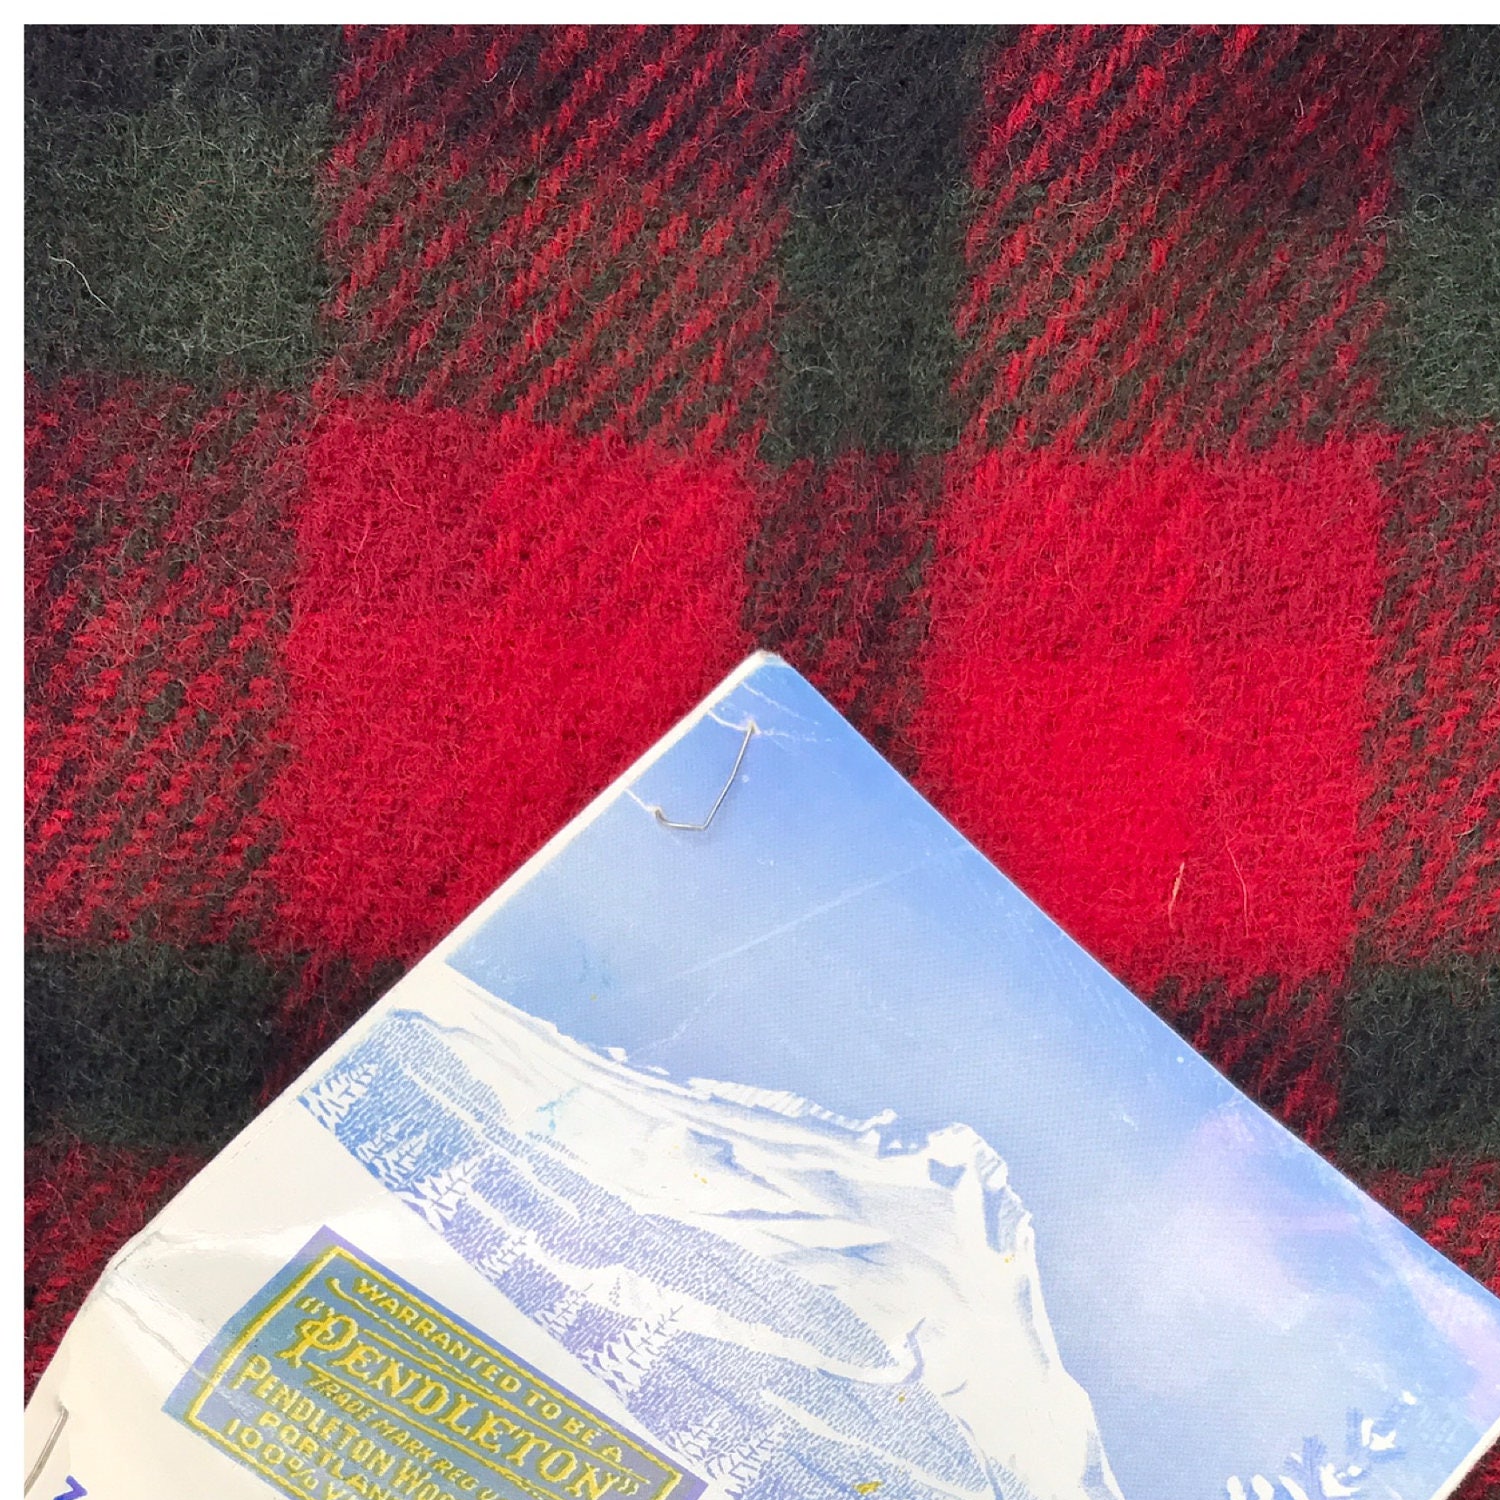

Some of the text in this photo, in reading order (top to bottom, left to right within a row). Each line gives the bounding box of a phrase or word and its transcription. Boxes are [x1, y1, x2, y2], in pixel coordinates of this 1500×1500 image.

[231, 1353, 395, 1477] PENDLETON
[354, 1277, 623, 1463] WARRANTED TO BE A
[225, 1418, 320, 1490] 100%
[370, 1418, 437, 1463] MARK
